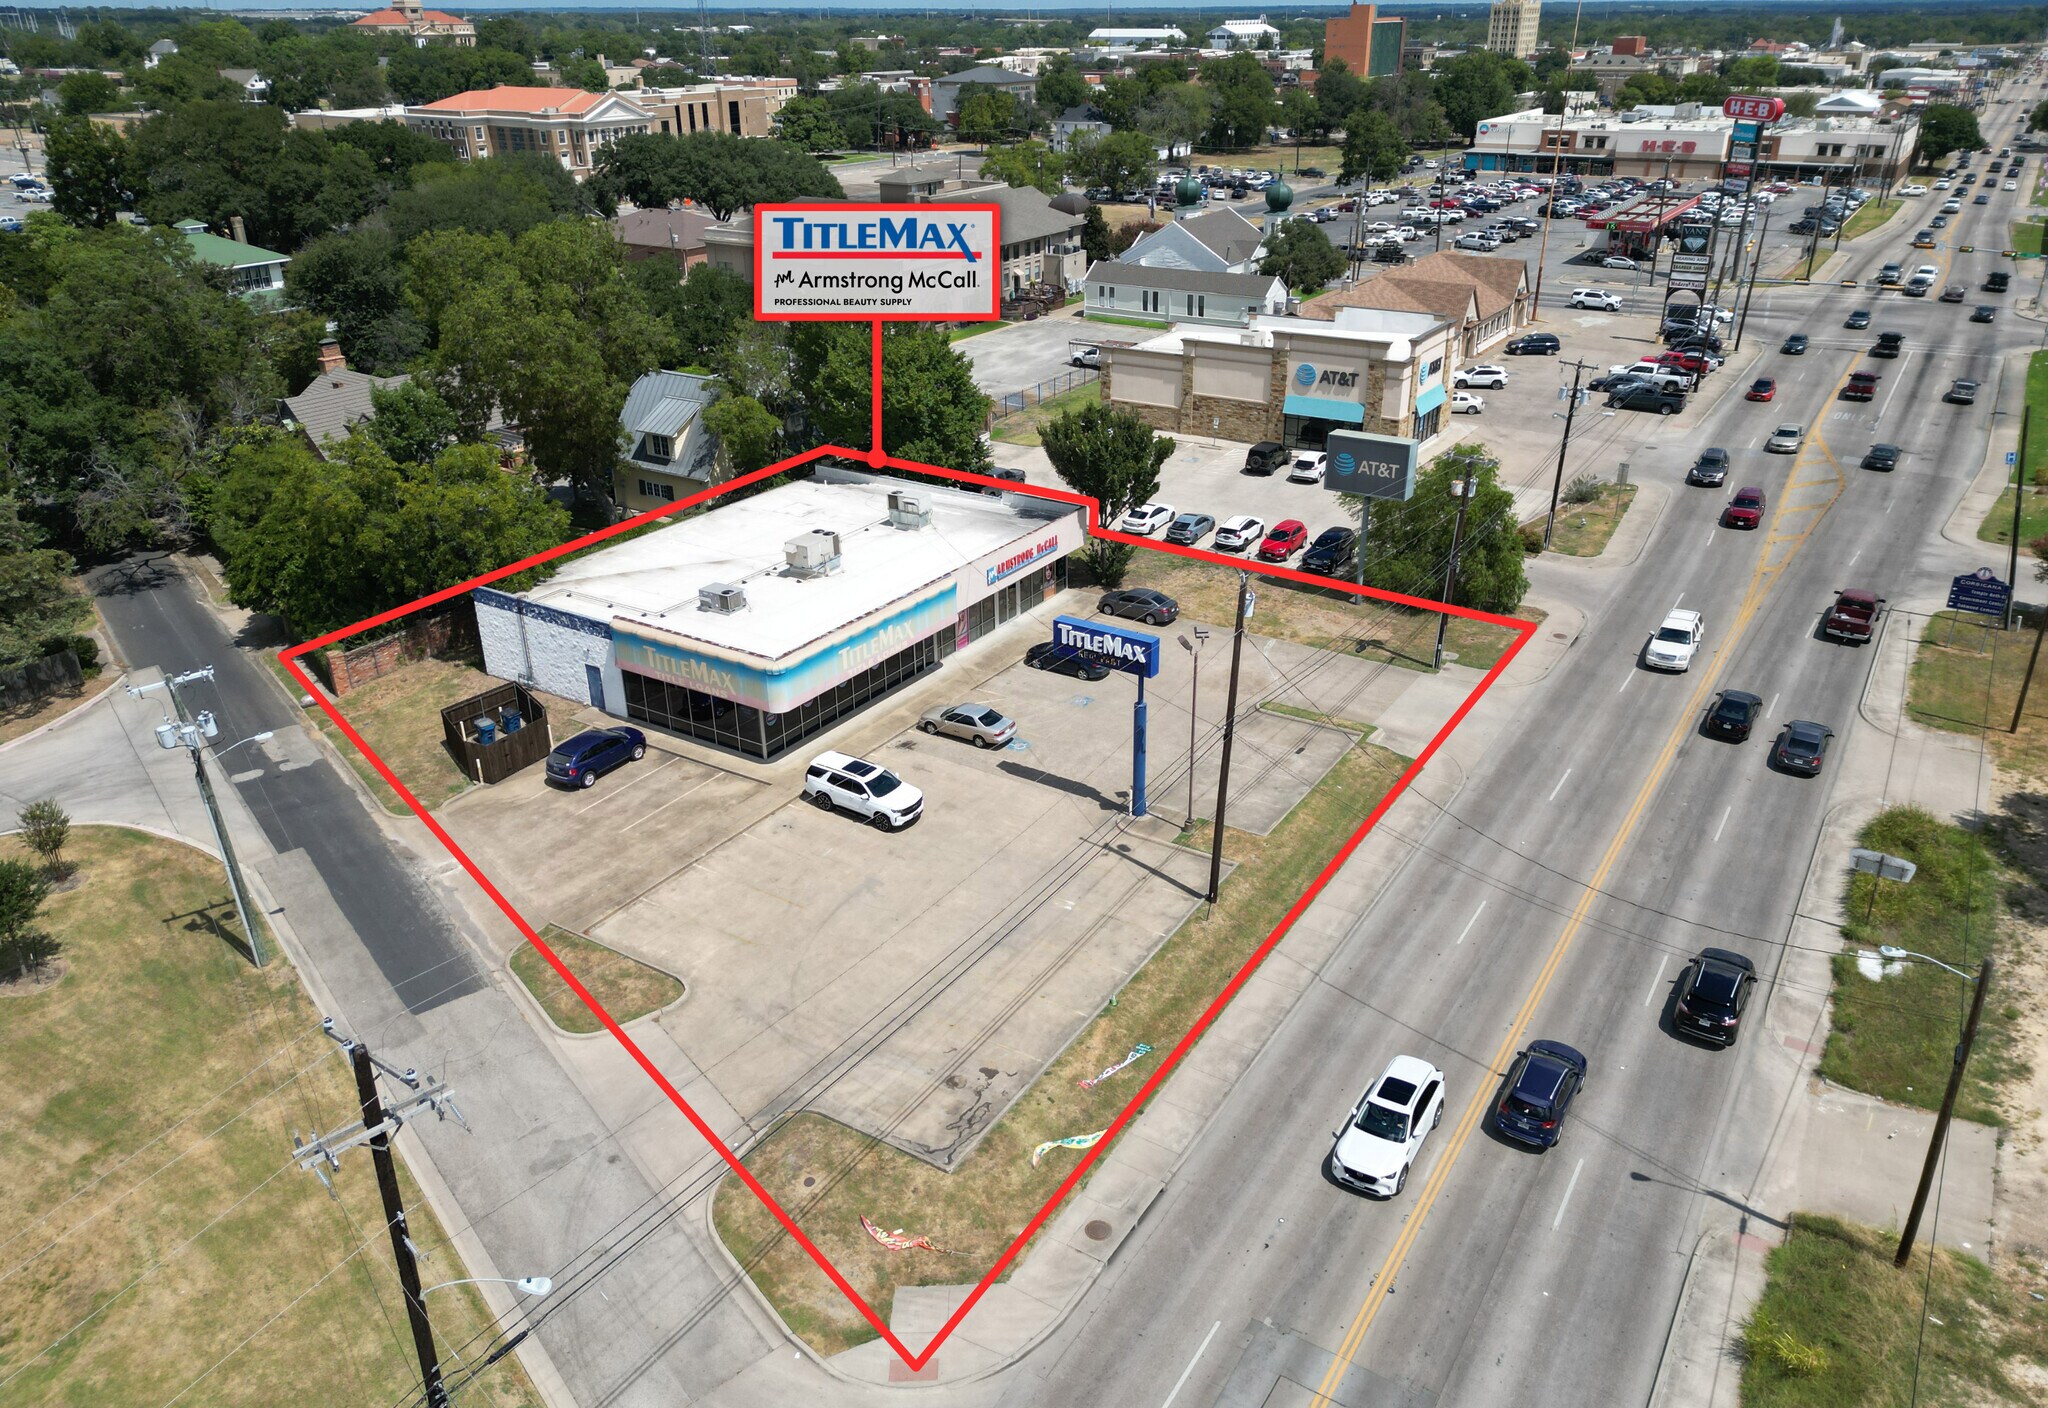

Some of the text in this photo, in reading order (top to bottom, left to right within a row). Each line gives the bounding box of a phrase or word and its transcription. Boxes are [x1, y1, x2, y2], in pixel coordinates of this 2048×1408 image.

[1319, 370, 1359, 387] AT&T
[1357, 460, 1400, 479] AT&T
[1960, 579, 2002, 590] CORSICANA
[1958, 595, 1987, 604] Government
[655, 671, 728, 698] TITLE LOANS
